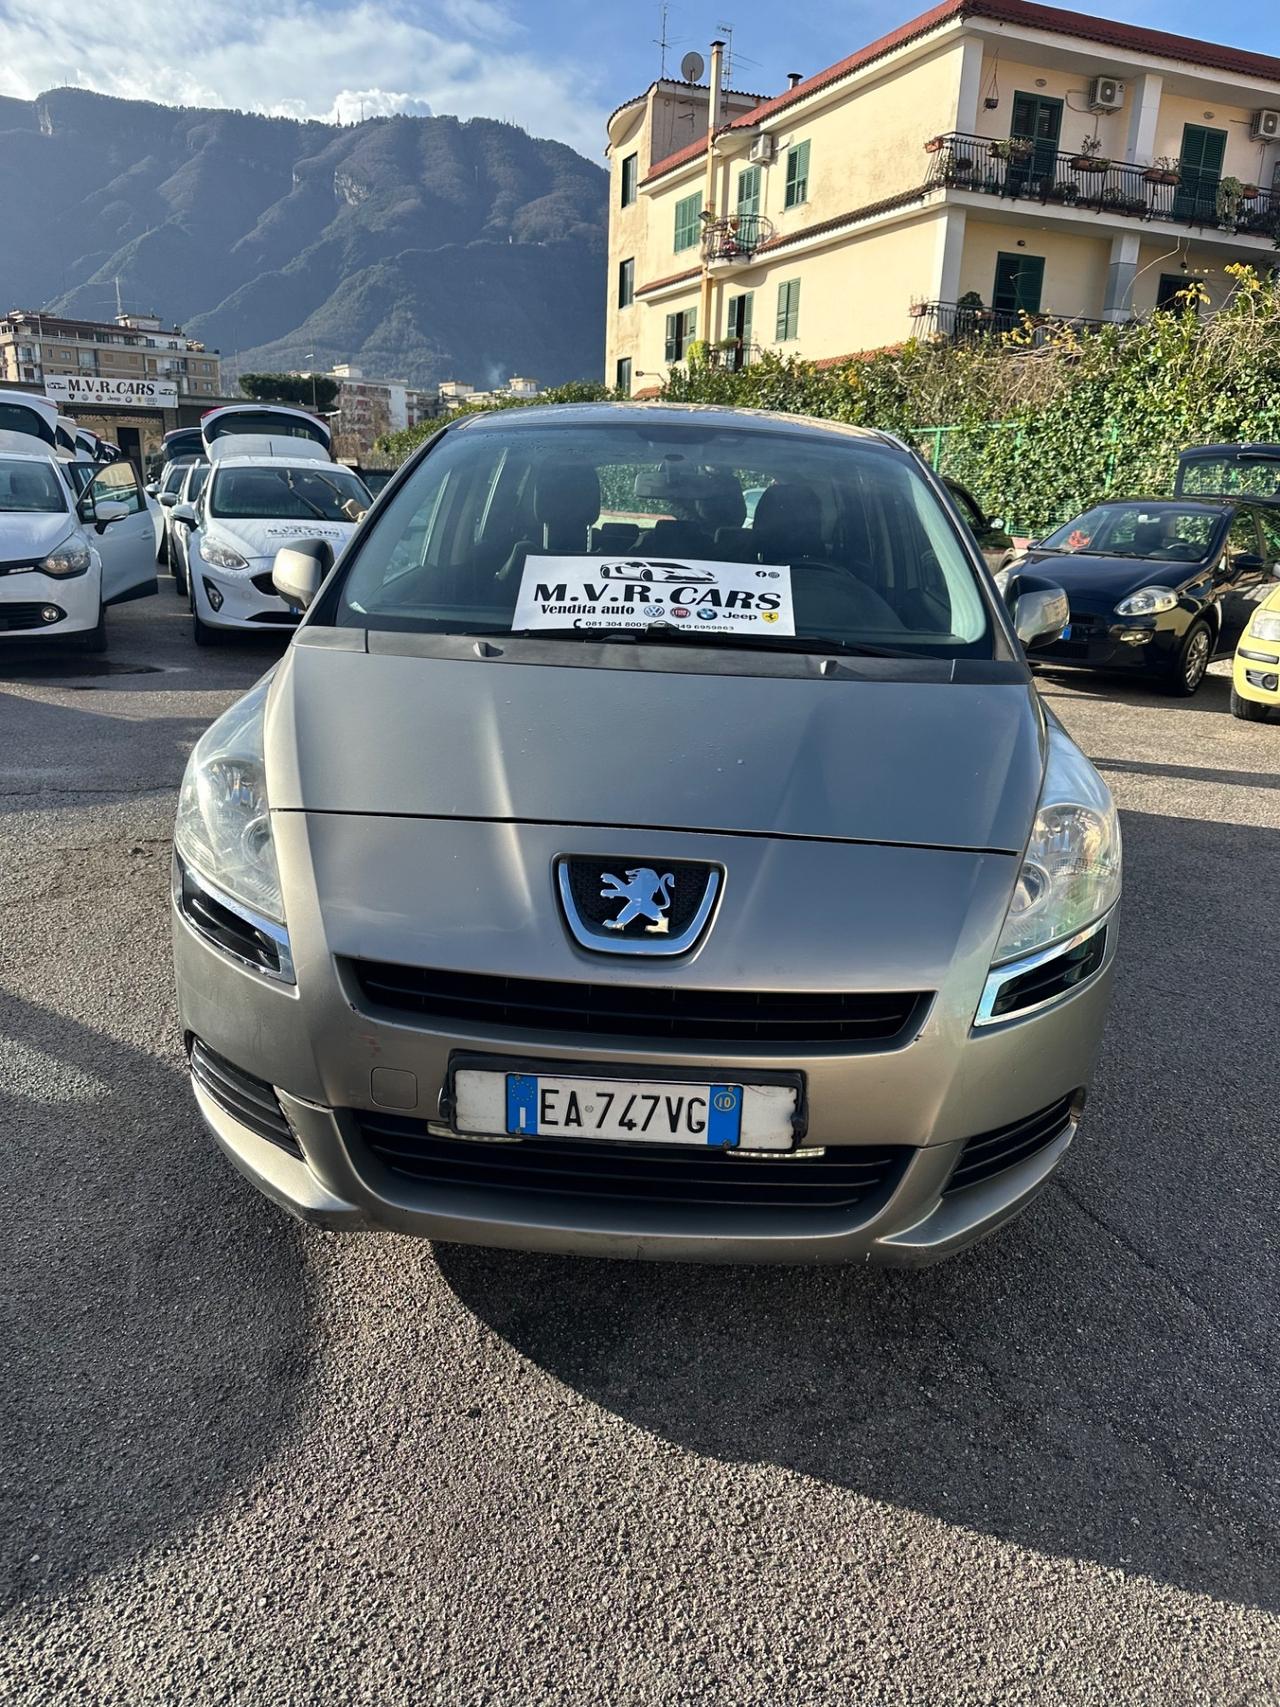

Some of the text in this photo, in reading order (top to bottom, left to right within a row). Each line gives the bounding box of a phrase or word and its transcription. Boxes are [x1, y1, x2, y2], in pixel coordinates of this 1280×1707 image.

[541, 604, 635, 616] Vendita auto
[722, 612, 758, 621] Jeep
